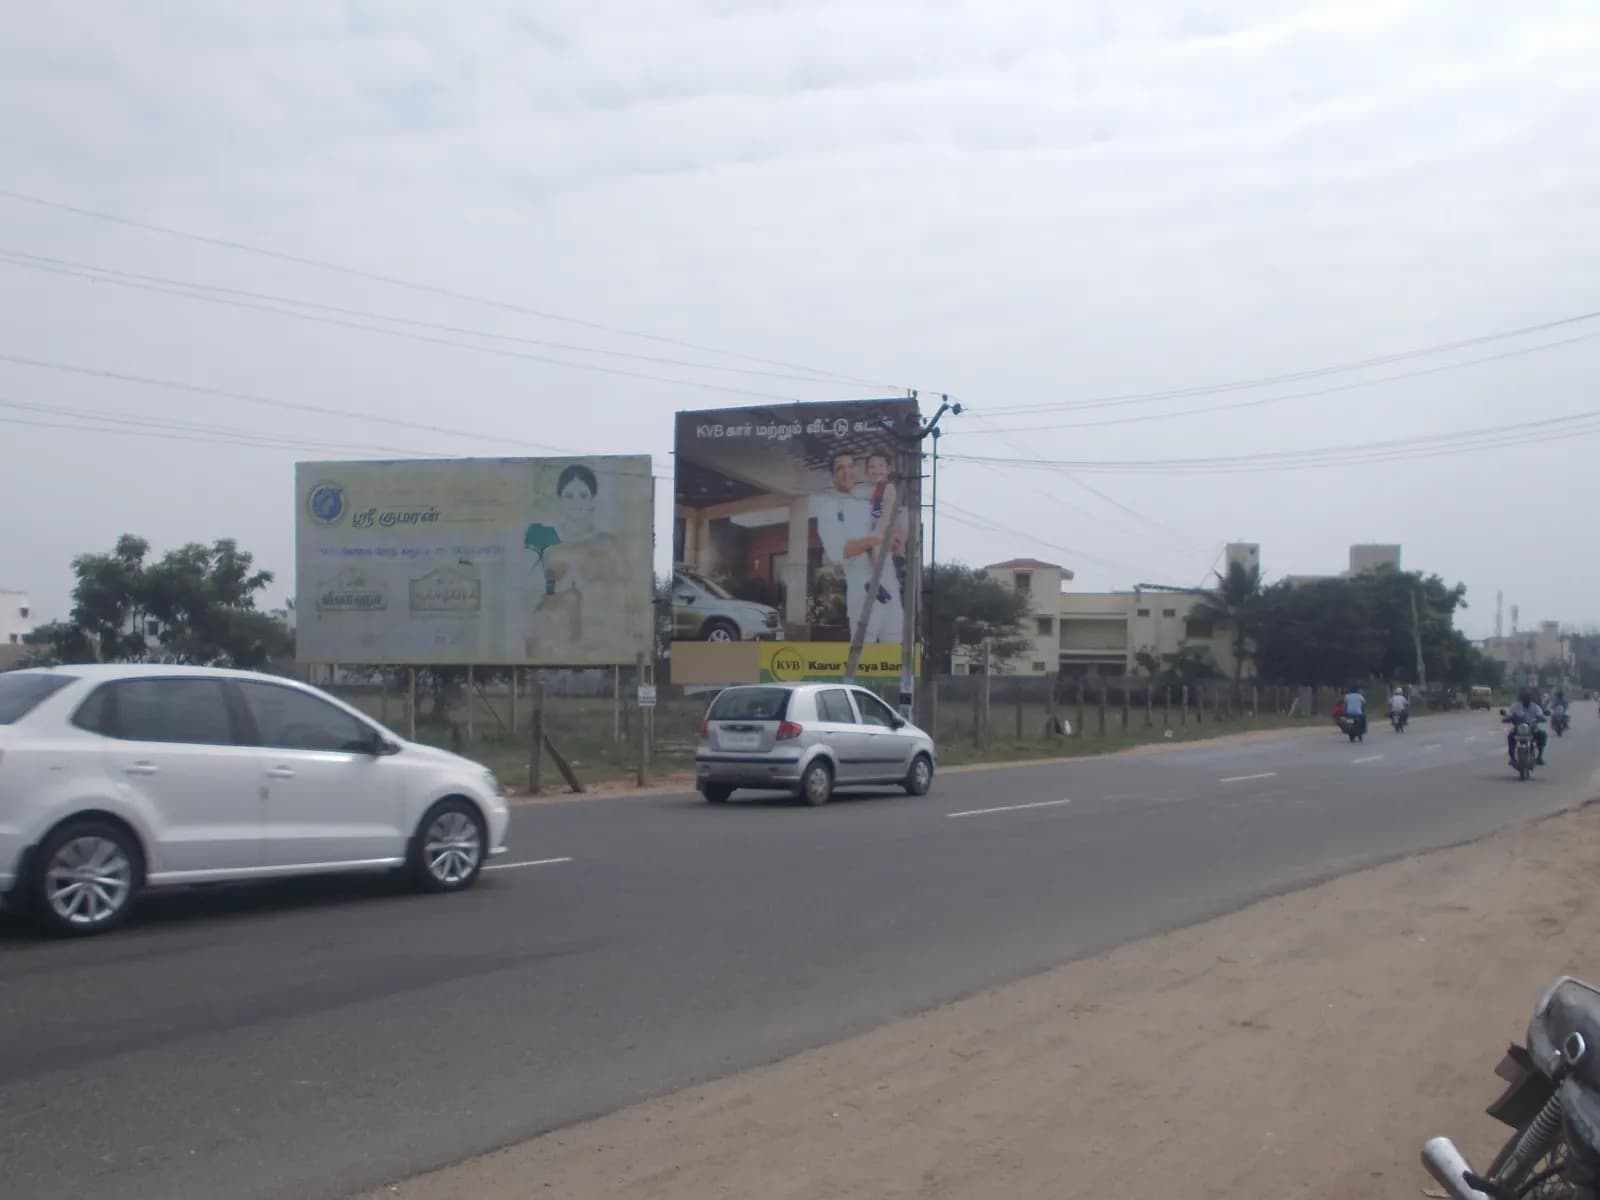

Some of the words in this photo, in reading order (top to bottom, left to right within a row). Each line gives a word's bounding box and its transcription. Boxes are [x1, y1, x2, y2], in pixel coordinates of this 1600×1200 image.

[697, 424, 724, 438] KVB
[725, 423, 752, 437] கார்
[756, 419, 802, 440] மற்றும்
[806, 417, 849, 438] வீட்டு
[378, 506, 441, 527] குமரன்
[776, 660, 801, 671] KVB
[808, 661, 842, 671] Karur
[844, 661, 878, 673] sya
[880, 661, 903, 671] Ban
